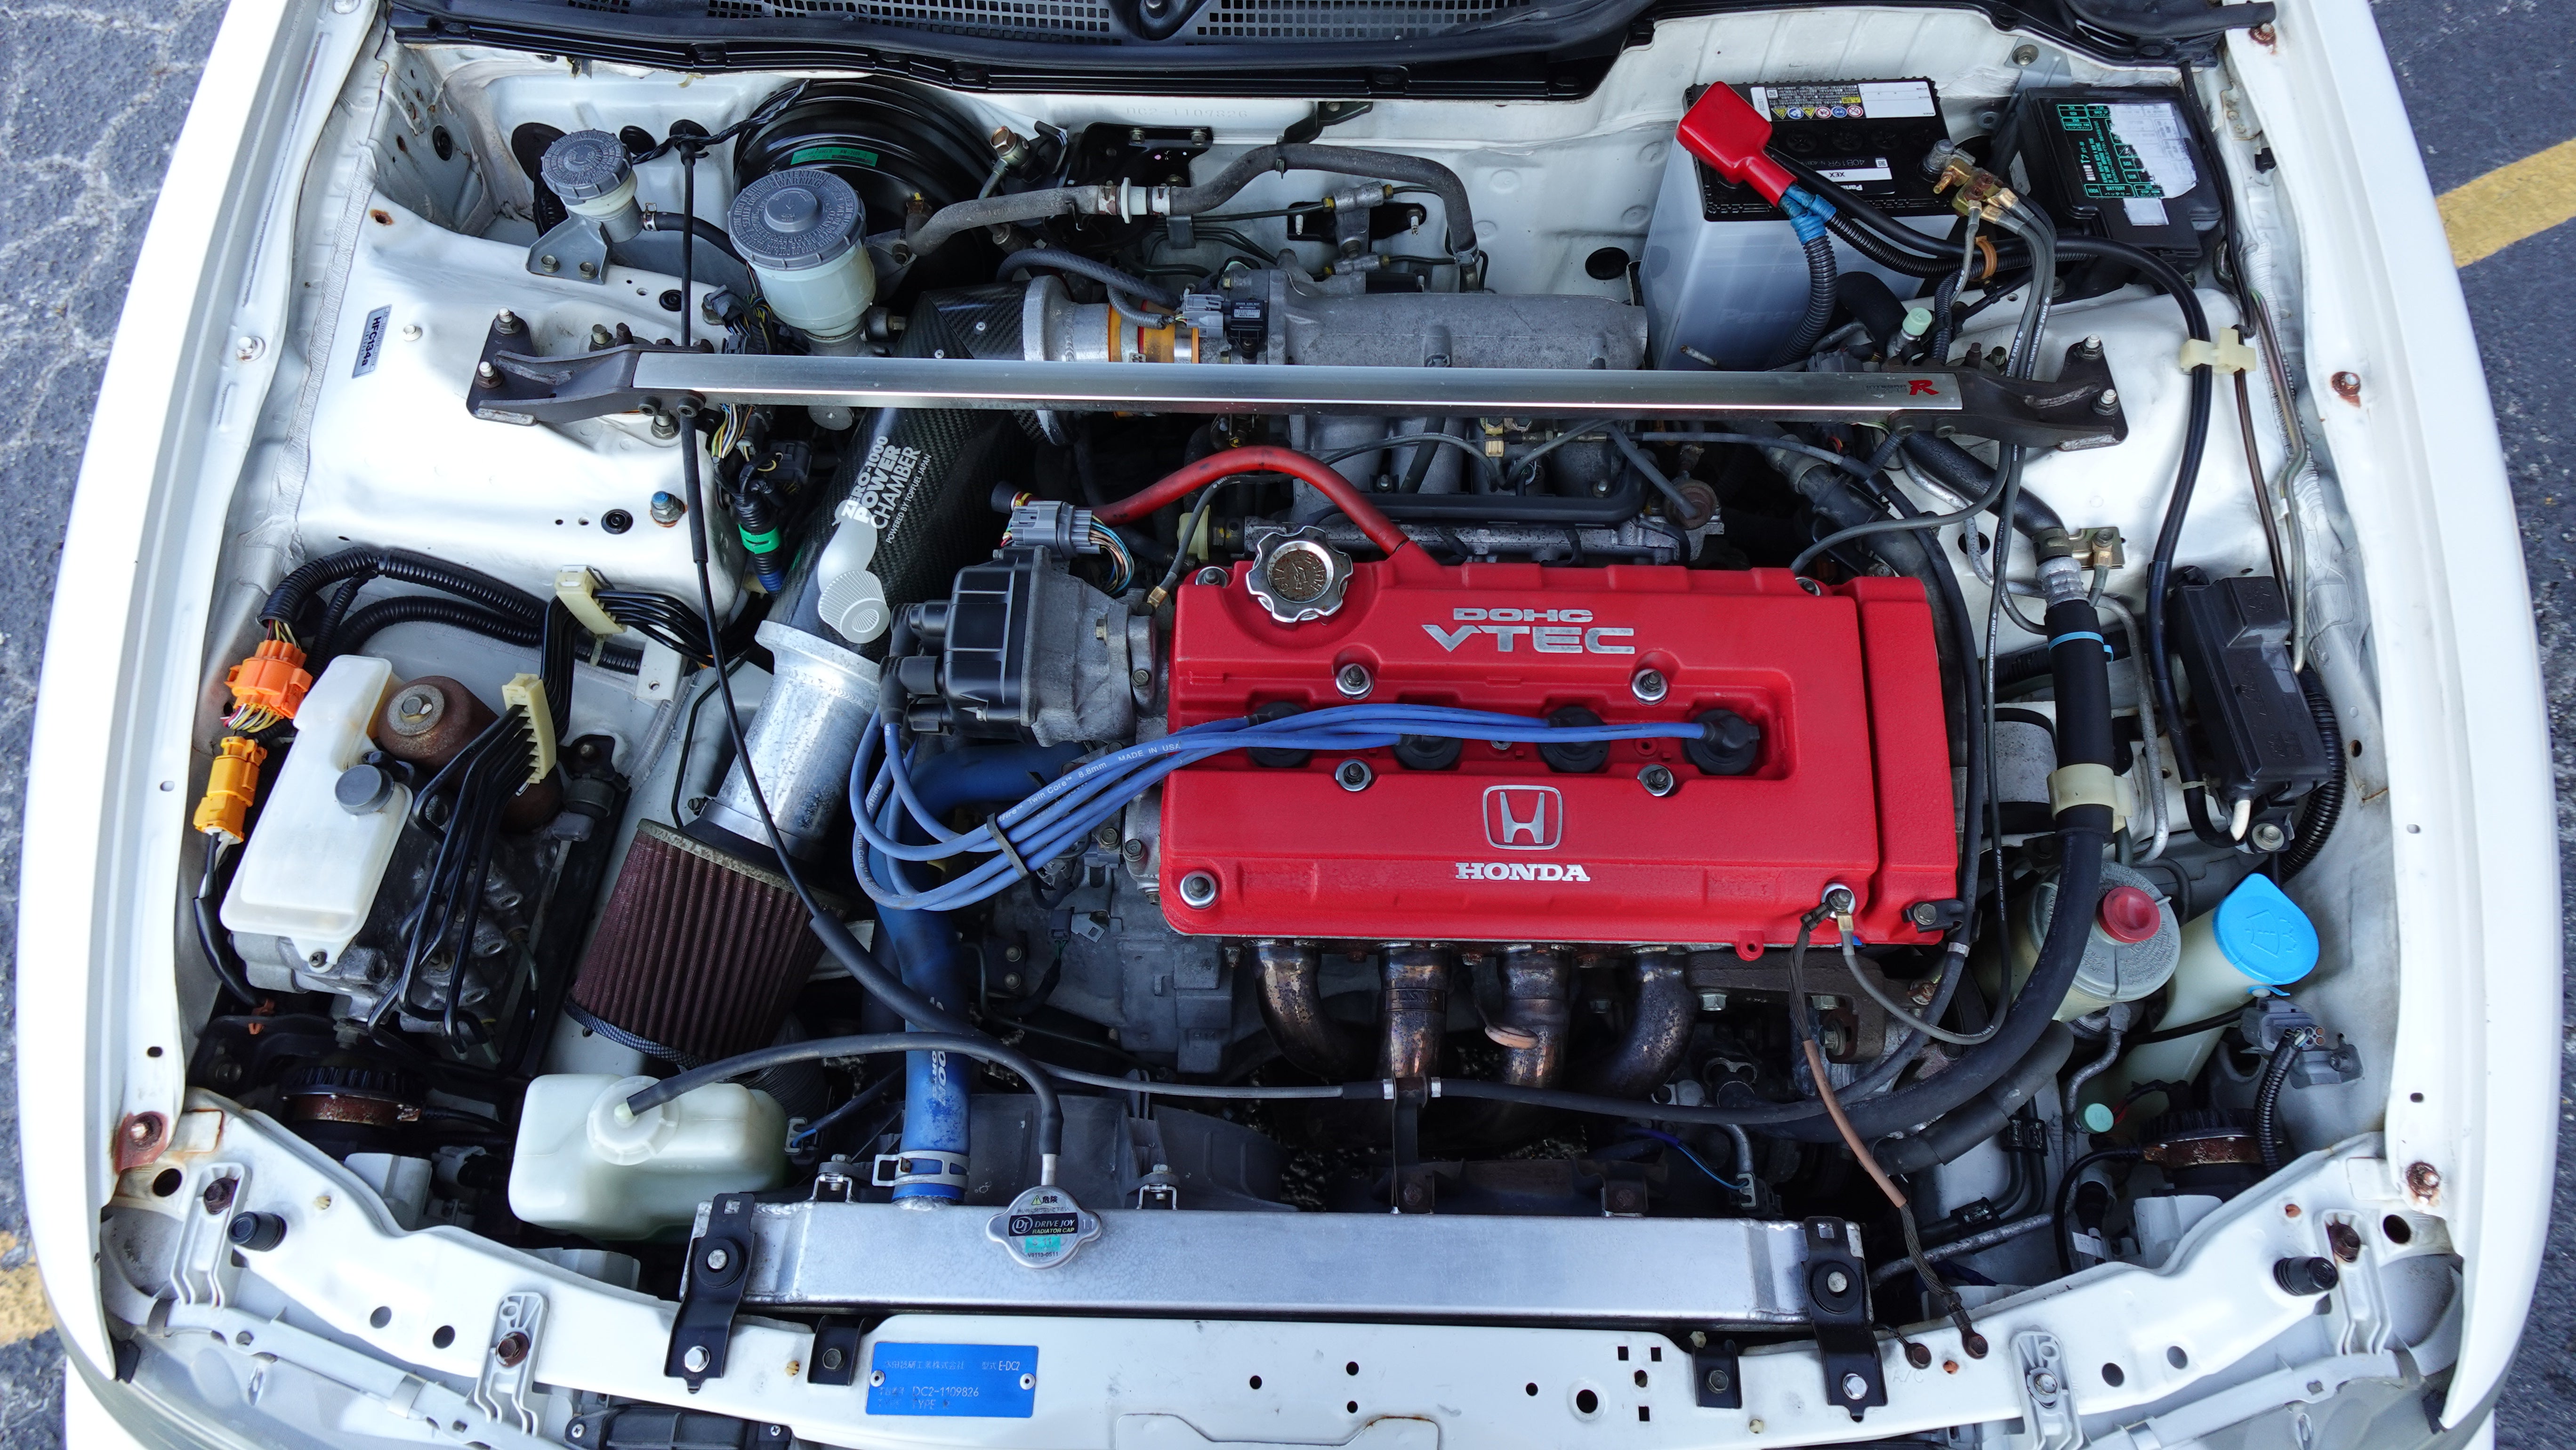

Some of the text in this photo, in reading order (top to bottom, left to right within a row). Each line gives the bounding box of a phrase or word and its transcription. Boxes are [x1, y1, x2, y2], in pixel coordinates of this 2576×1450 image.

[774, 169, 827, 180] ATTENTION
[778, 177, 823, 188] WARNING
[361, 316, 381, 367] HFC134a
[1908, 380, 1940, 395] R
[841, 436, 889, 520] ZERO-1000
[853, 445, 902, 524] POWER
[870, 446, 921, 530] CHAMBER
[886, 453, 932, 544] POWERED BY TOPFUEL JAPAN
[1453, 607, 1594, 623] DOHC
[1421, 624, 1635, 655] VTEC
[1027, 792, 1046, 806] Twin
[1078, 761, 1107, 778] 8.8mm
[1118, 749, 1144, 762] MADE
[1148, 746, 1158, 754] IN
[1163, 742, 1182, 752] USA
[867, 782, 883, 814] SplitFi
[1455, 862, 1591, 883] HONDA
[1042, 1195, 1058, 1204] 危険
[1034, 1220, 1059, 1228] DRIVE
[1060, 1219, 1075, 1227] JOY
[1083, 1218, 1095, 1230] 1.1
[998, 1361, 1020, 1371] E-DC2
[1892, 1369, 1924, 1383] A/C
[912, 1385, 979, 1397] DC2-1109826
